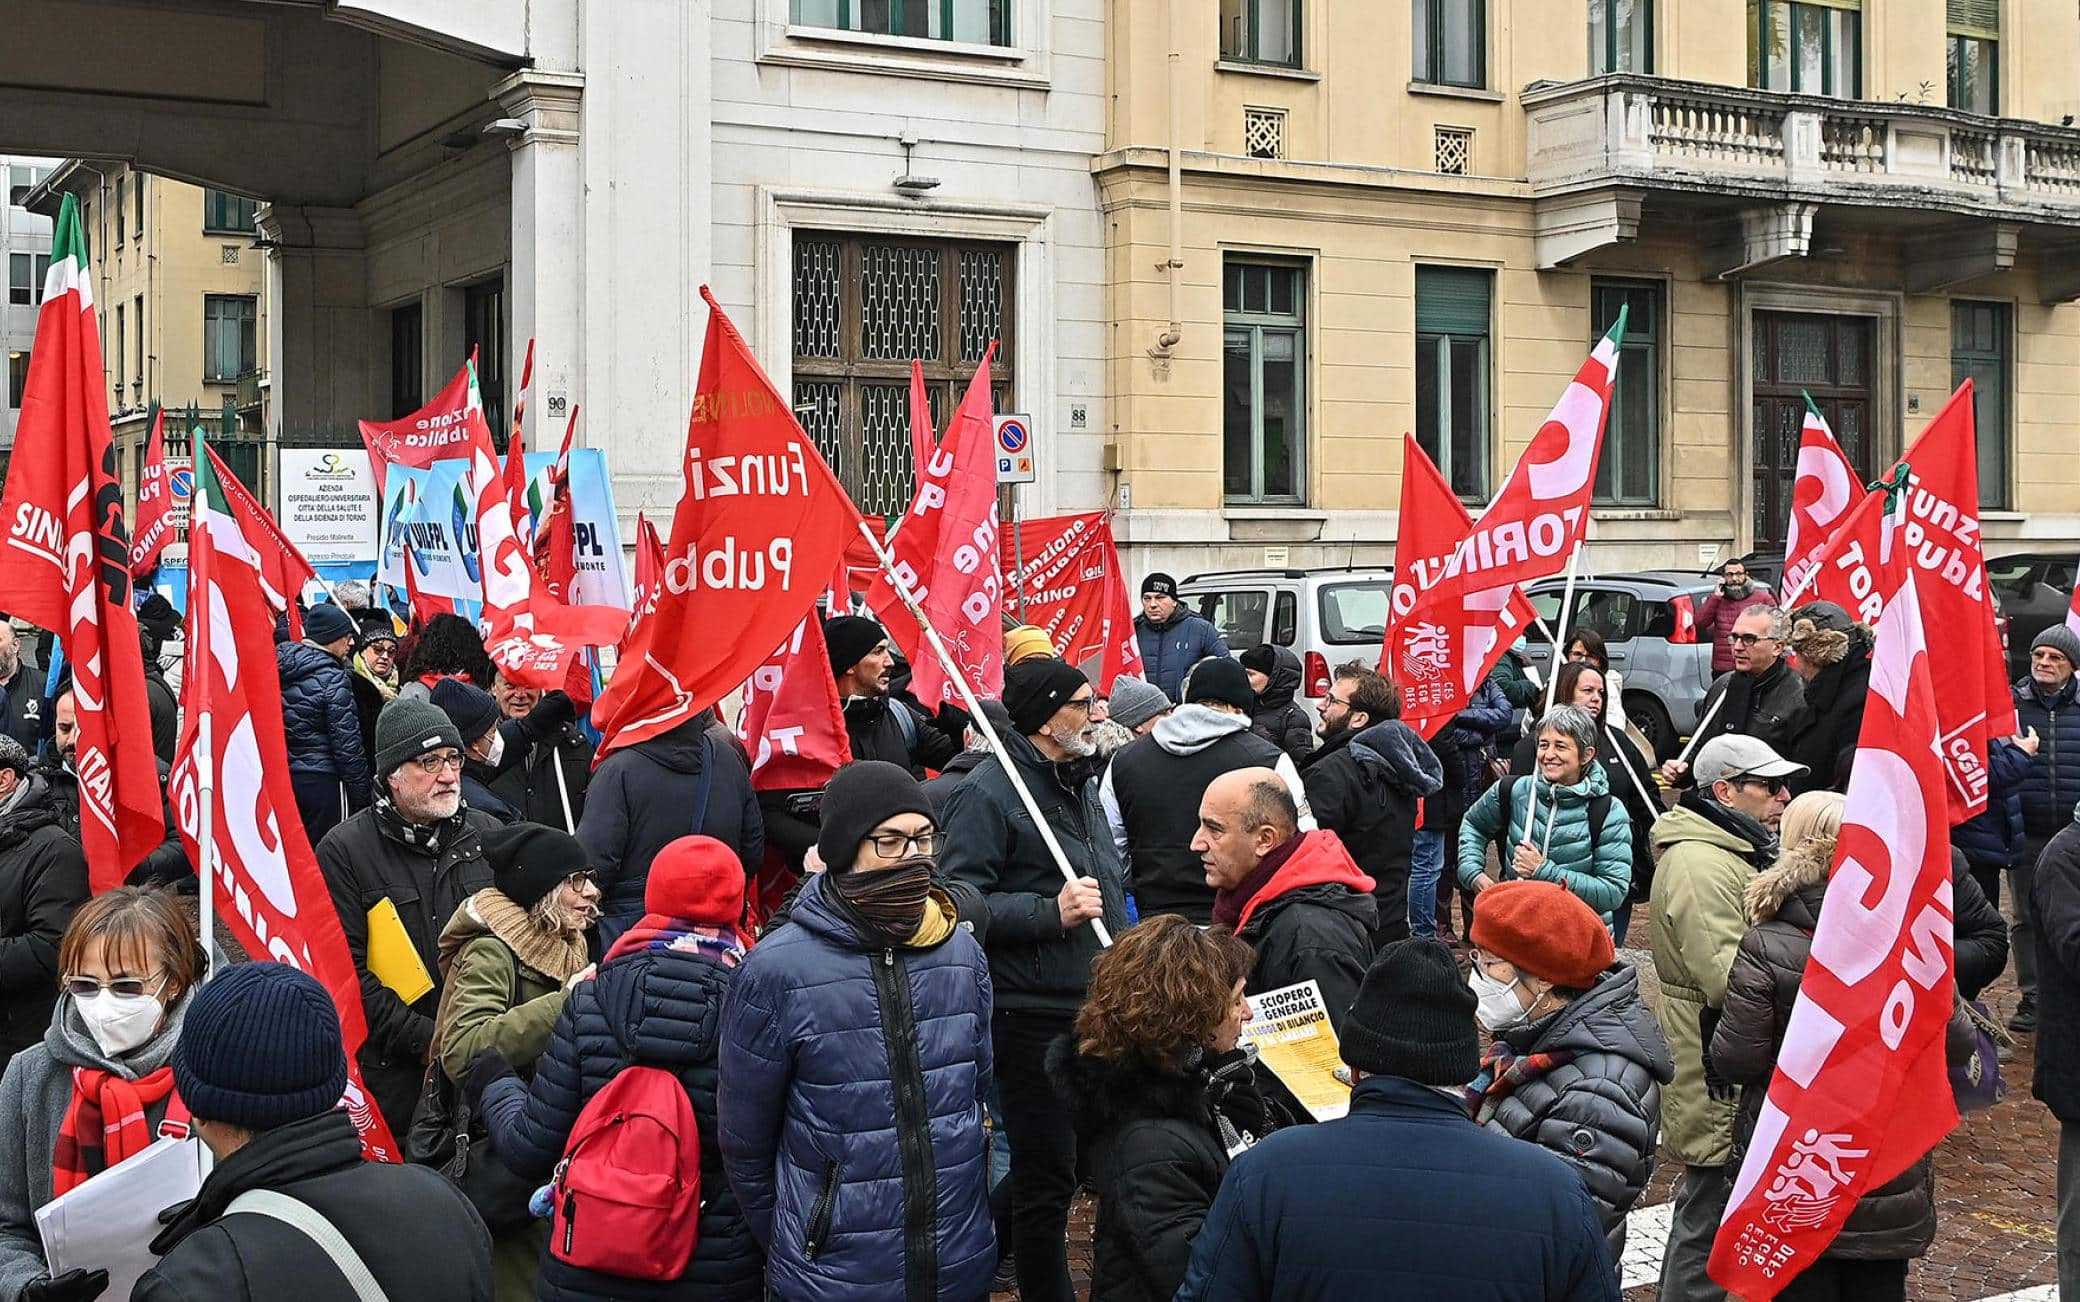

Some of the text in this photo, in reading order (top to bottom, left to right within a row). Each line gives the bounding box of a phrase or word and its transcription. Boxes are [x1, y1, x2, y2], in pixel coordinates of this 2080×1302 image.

[548, 397, 566, 410] 90
[1072, 410, 1086, 421] 88
[1906, 474, 1981, 552] Funz
[1260, 986, 1312, 1009] SCIOPERO
[1264, 998, 1318, 1020] GENERALE
[1276, 1020, 1287, 1032] DI
[1286, 1011, 1325, 1029] BILANCIO
